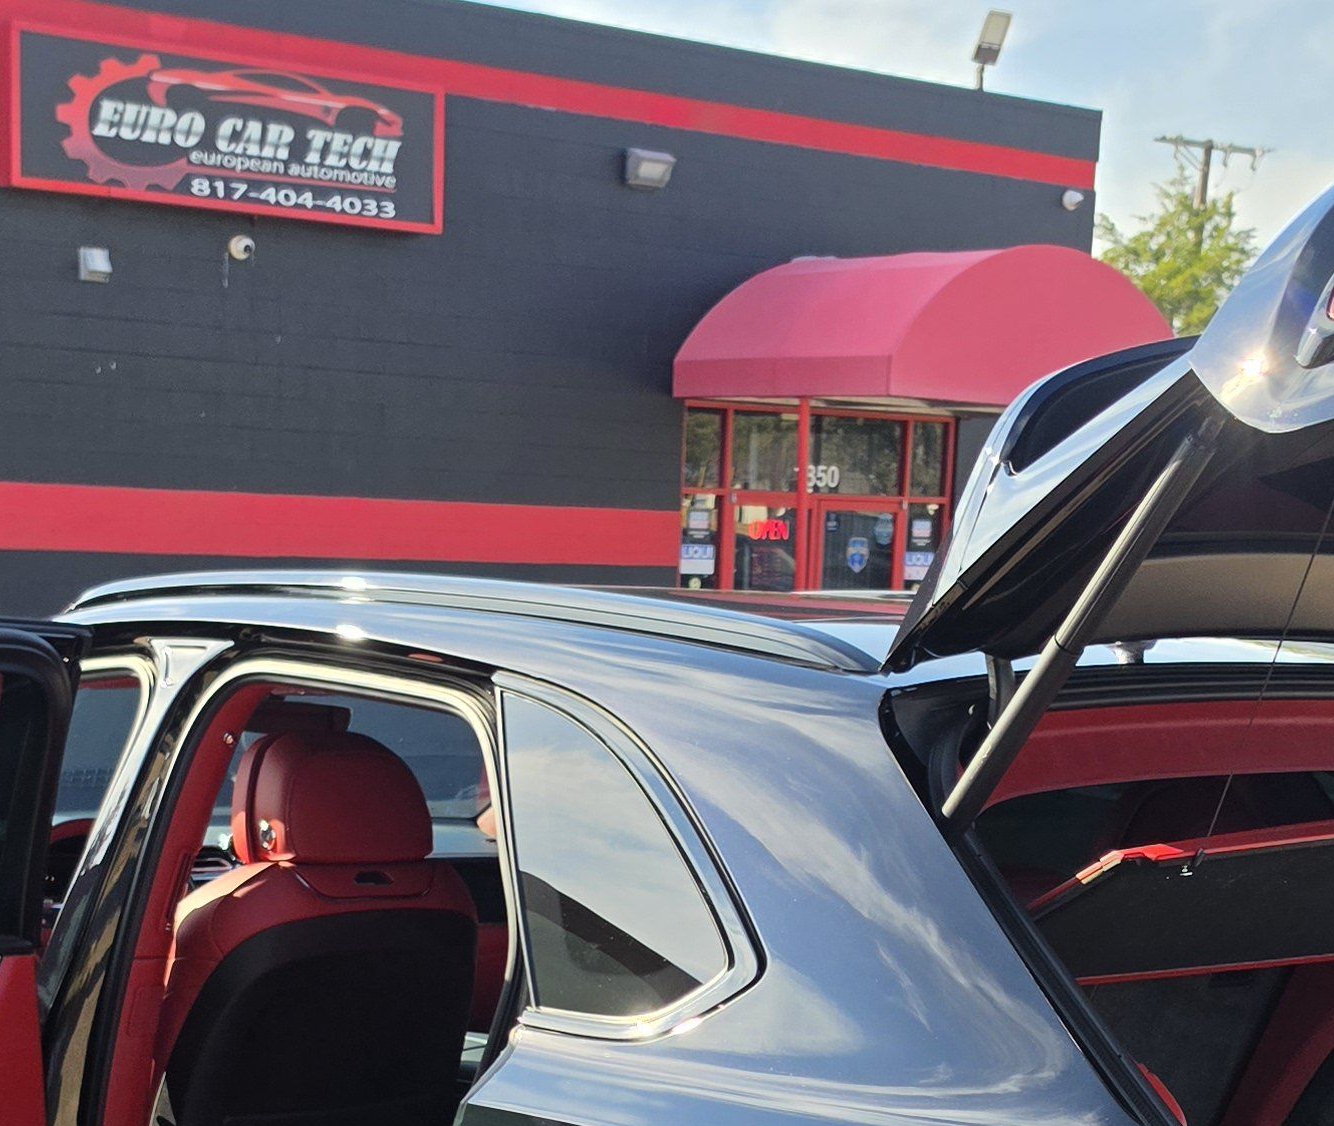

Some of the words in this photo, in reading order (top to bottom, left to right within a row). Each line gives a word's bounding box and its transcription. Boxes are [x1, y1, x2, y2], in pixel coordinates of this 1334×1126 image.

[92, 99, 205, 148] EURO
[216, 117, 295, 161] CAR
[304, 129, 402, 174] TECH
[189, 150, 285, 174] european
[287, 162, 397, 189] automotive
[190, 178, 396, 219] 817-404-4033
[748, 519, 789, 540] OPEN
